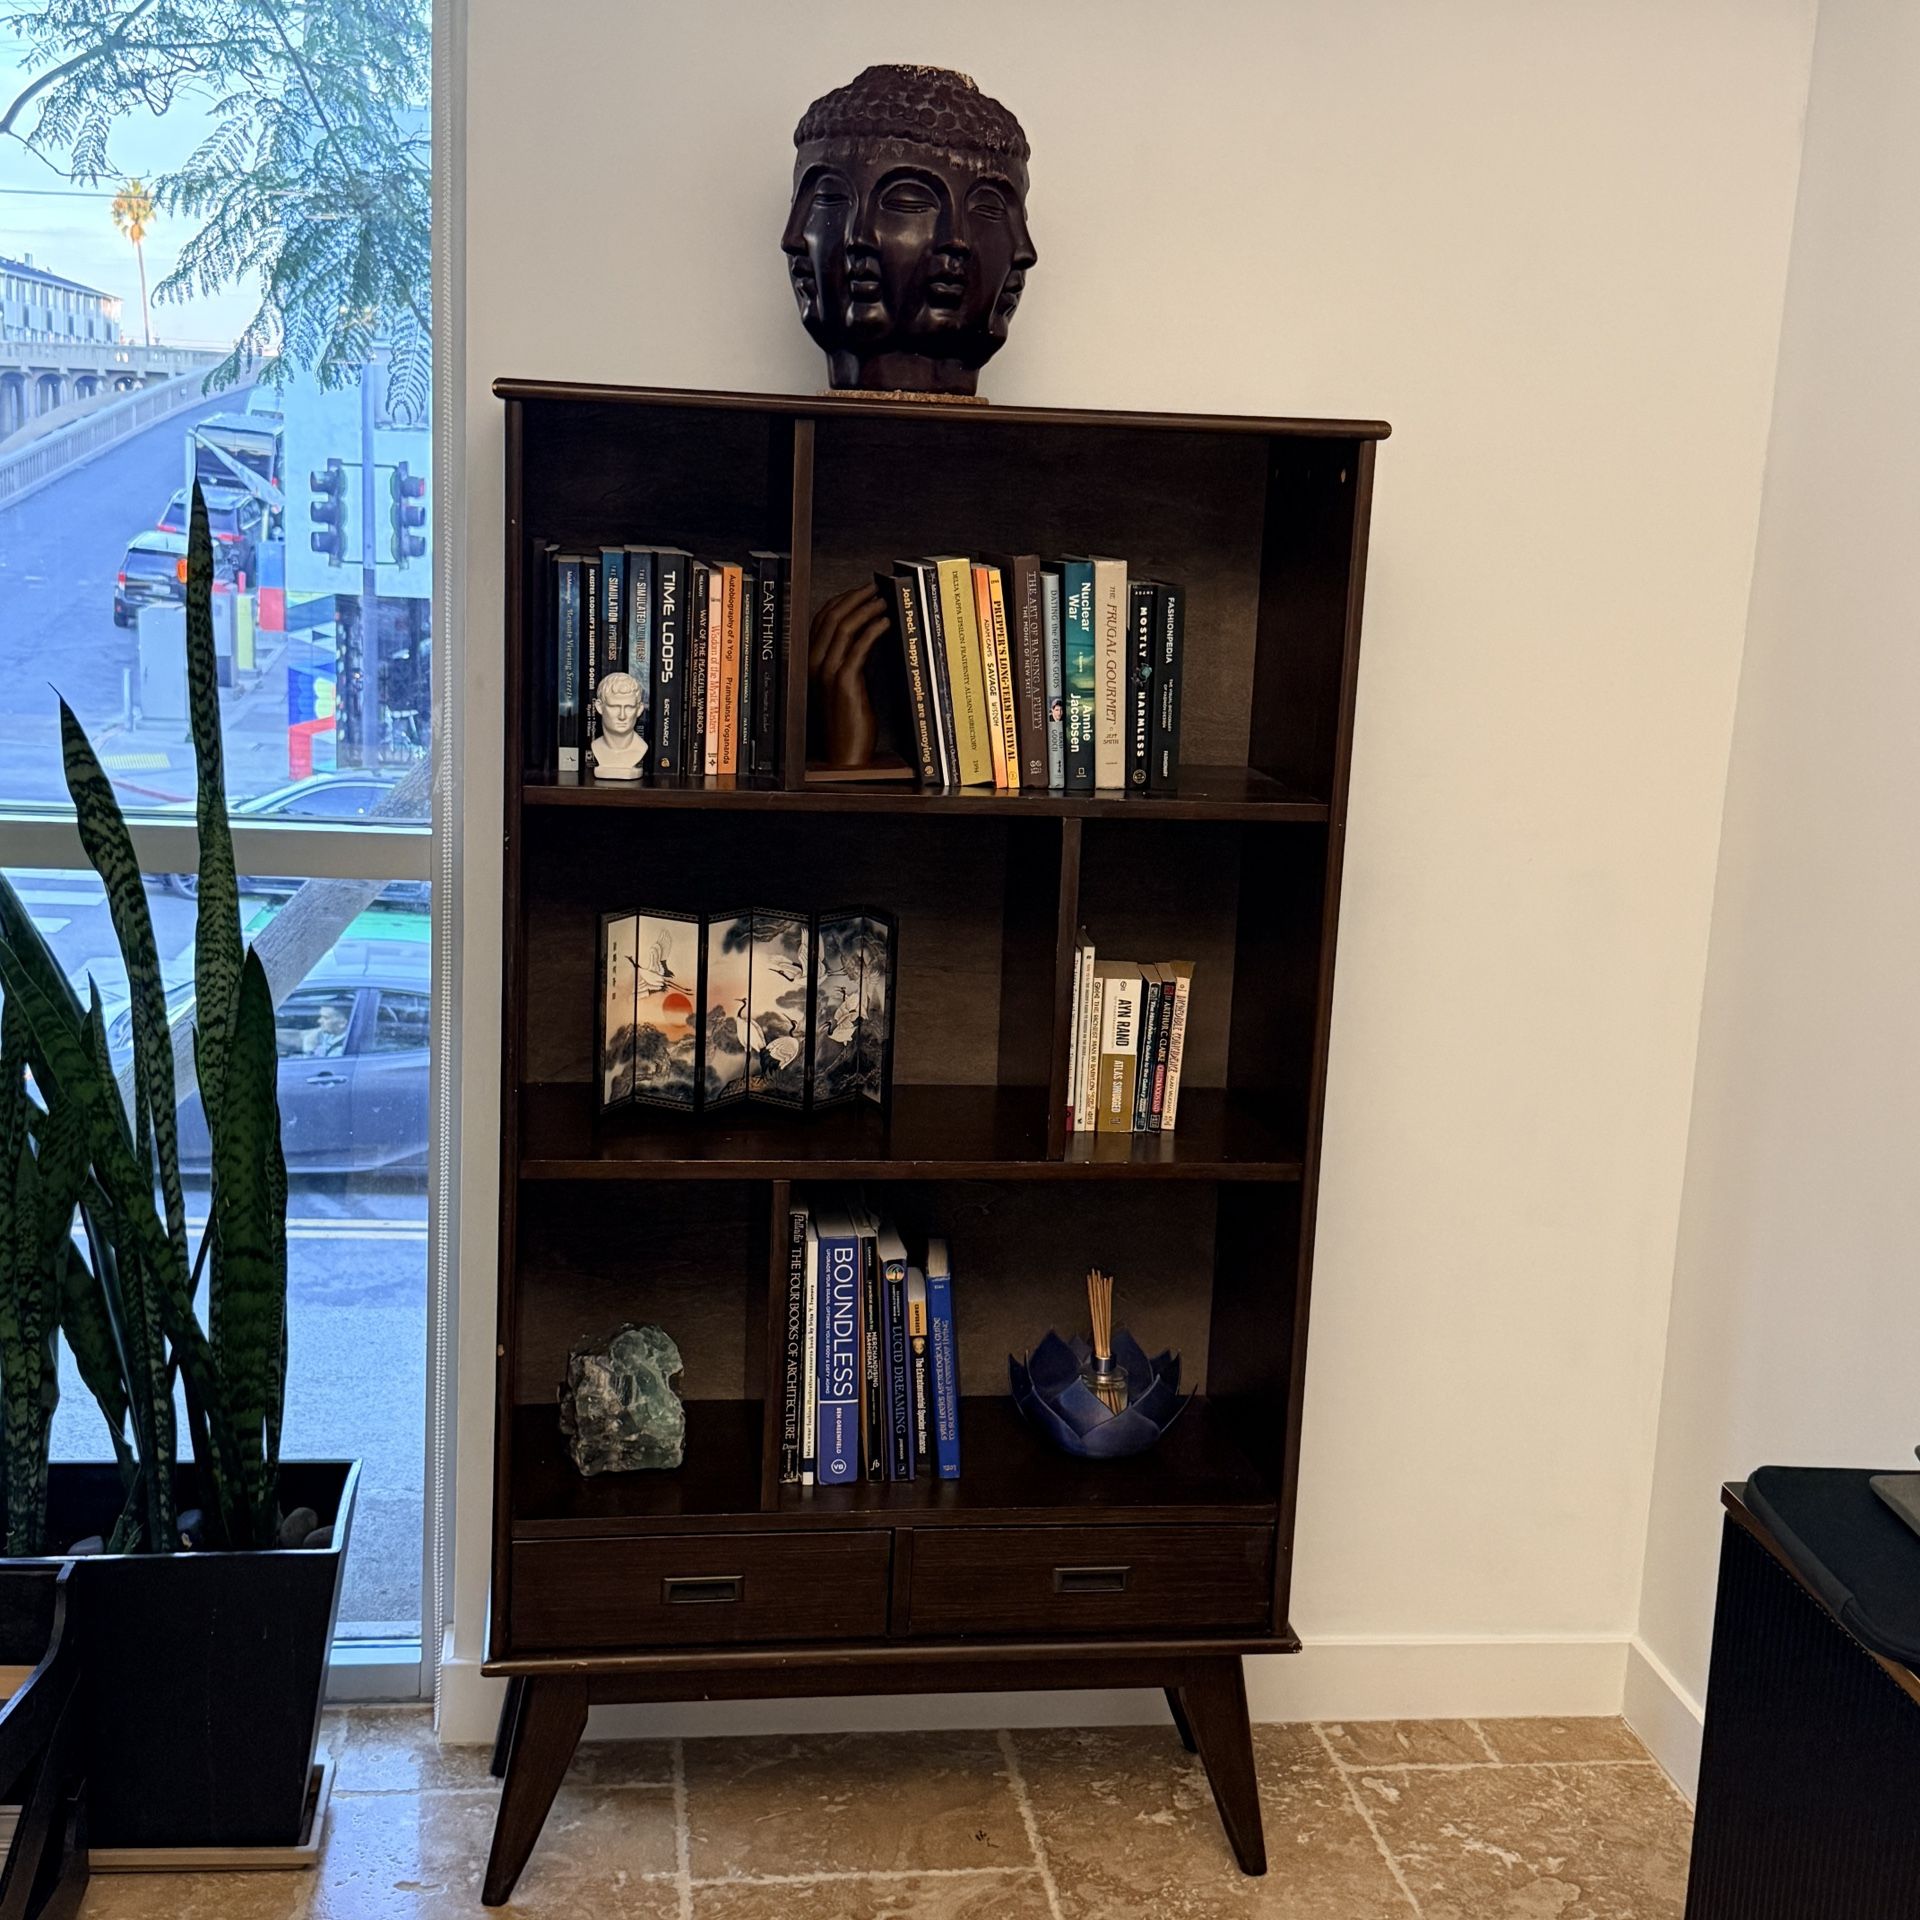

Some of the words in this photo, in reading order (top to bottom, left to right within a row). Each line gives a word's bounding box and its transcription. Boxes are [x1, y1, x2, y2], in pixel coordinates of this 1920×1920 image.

[663, 571, 676, 616] TIME
[1028, 571, 1037, 595] THE
[608, 578, 619, 623] SIMULATION
[636, 582, 647, 623] SIMULATED
[727, 574, 737, 628] Autobiography
[902, 588, 913, 609] Josh
[954, 594, 962, 615] KAPPA
[1030, 598, 1039, 620] ART
[1051, 590, 1059, 621] DATING
[1069, 594, 1080, 620] War
[1081, 582, 1092, 632] Nuclear
[566, 609, 574, 638] Remote
[699, 629, 706, 639] OF
[727, 629, 735, 638] of
[762, 580, 775, 660] EARTHING
[905, 611, 915, 633] Peck
[956, 617, 966, 644] EPSILON
[994, 600, 1008, 655] PREPPER'S
[1031, 622, 1039, 636] OF
[1051, 623, 1059, 636] the
[1106, 604, 1118, 657] FRUGAL
[1139, 607, 1148, 658] MOSTLY
[1165, 597, 1176, 664] FASHIONPEDIA
[565, 640, 574, 671] Viewing
[608, 624, 617, 660] HYPOTHESIS
[662, 622, 676, 683] LOOPS
[711, 626, 720, 656] Wisdom
[725, 645, 734, 662] Yogi
[907, 638, 920, 668] happy
[1023, 648, 1029, 657] OF
[1051, 638, 1060, 666] GREEK
[711, 657, 720, 665] of
[711, 665, 719, 679] the
[960, 646, 971, 686] FRATERNITY
[1031, 639, 1041, 682] RAISING
[566, 672, 574, 699] Secrets
[697, 658, 705, 695] PEACEFUL
[911, 669, 924, 702] people
[987, 663, 997, 696] SAVAGE
[998, 657, 1012, 712] LONG-TERM
[1033, 686, 1041, 695] A
[1052, 669, 1060, 689] GODS
[708, 680, 719, 704] Mystic
[964, 686, 974, 714] ALUMNI
[1106, 660, 1118, 725] GOURMET
[696, 697, 705, 735] WARRIOR
[709, 706, 718, 734] Masters
[917, 703, 926, 719] are
[991, 702, 999, 726] WISDOM
[1033, 696, 1043, 731] PUPPY
[1070, 693, 1081, 752] Jacobsen
[1083, 704, 1093, 741] Annie
[1136, 692, 1146, 758] HARMLESS
[722, 723, 731, 764] Yogananda
[919, 720, 933, 763] annoying
[967, 715, 977, 752] DIRECTORY
[1003, 713, 1016, 762] SURVIVAL
[1118, 999, 1132, 1017] AYN
[1161, 1001, 1171, 1030] ARTHUR
[1172, 995, 1187, 1031] INCREDIBLE
[1116, 1021, 1130, 1047] RAND
[1147, 1012, 1156, 1044] Hitchhiker's
[1158, 1038, 1168, 1062] CLARKE
[1168, 1032, 1184, 1073] COINCIDENCE
[1089, 1063, 1097, 1090] BABYLON
[1113, 1060, 1125, 1079] ATLAS
[1111, 1081, 1124, 1113] SHRUGGED
[1140, 1078, 1148, 1098] Galaxy
[1166, 1089, 1174, 1113] VAUGHAN
[793, 1214, 806, 1243] Palladio
[791, 1248, 802, 1270] THE
[790, 1272, 801, 1301] FOUR
[788, 1303, 800, 1340] BOOKS
[833, 1247, 853, 1397] BOUNDLESS
[787, 1343, 798, 1358] OF
[891, 1326, 904, 1363] LUCID
[915, 1358, 924, 1367] The
[784, 1359, 797, 1440] ARCHITECTURE
[893, 1366, 906, 1434] DREAMING
[916, 1368, 926, 1408] Extraterrestrial
[917, 1409, 926, 1430] Species
[918, 1430, 927, 1453] Almanac
